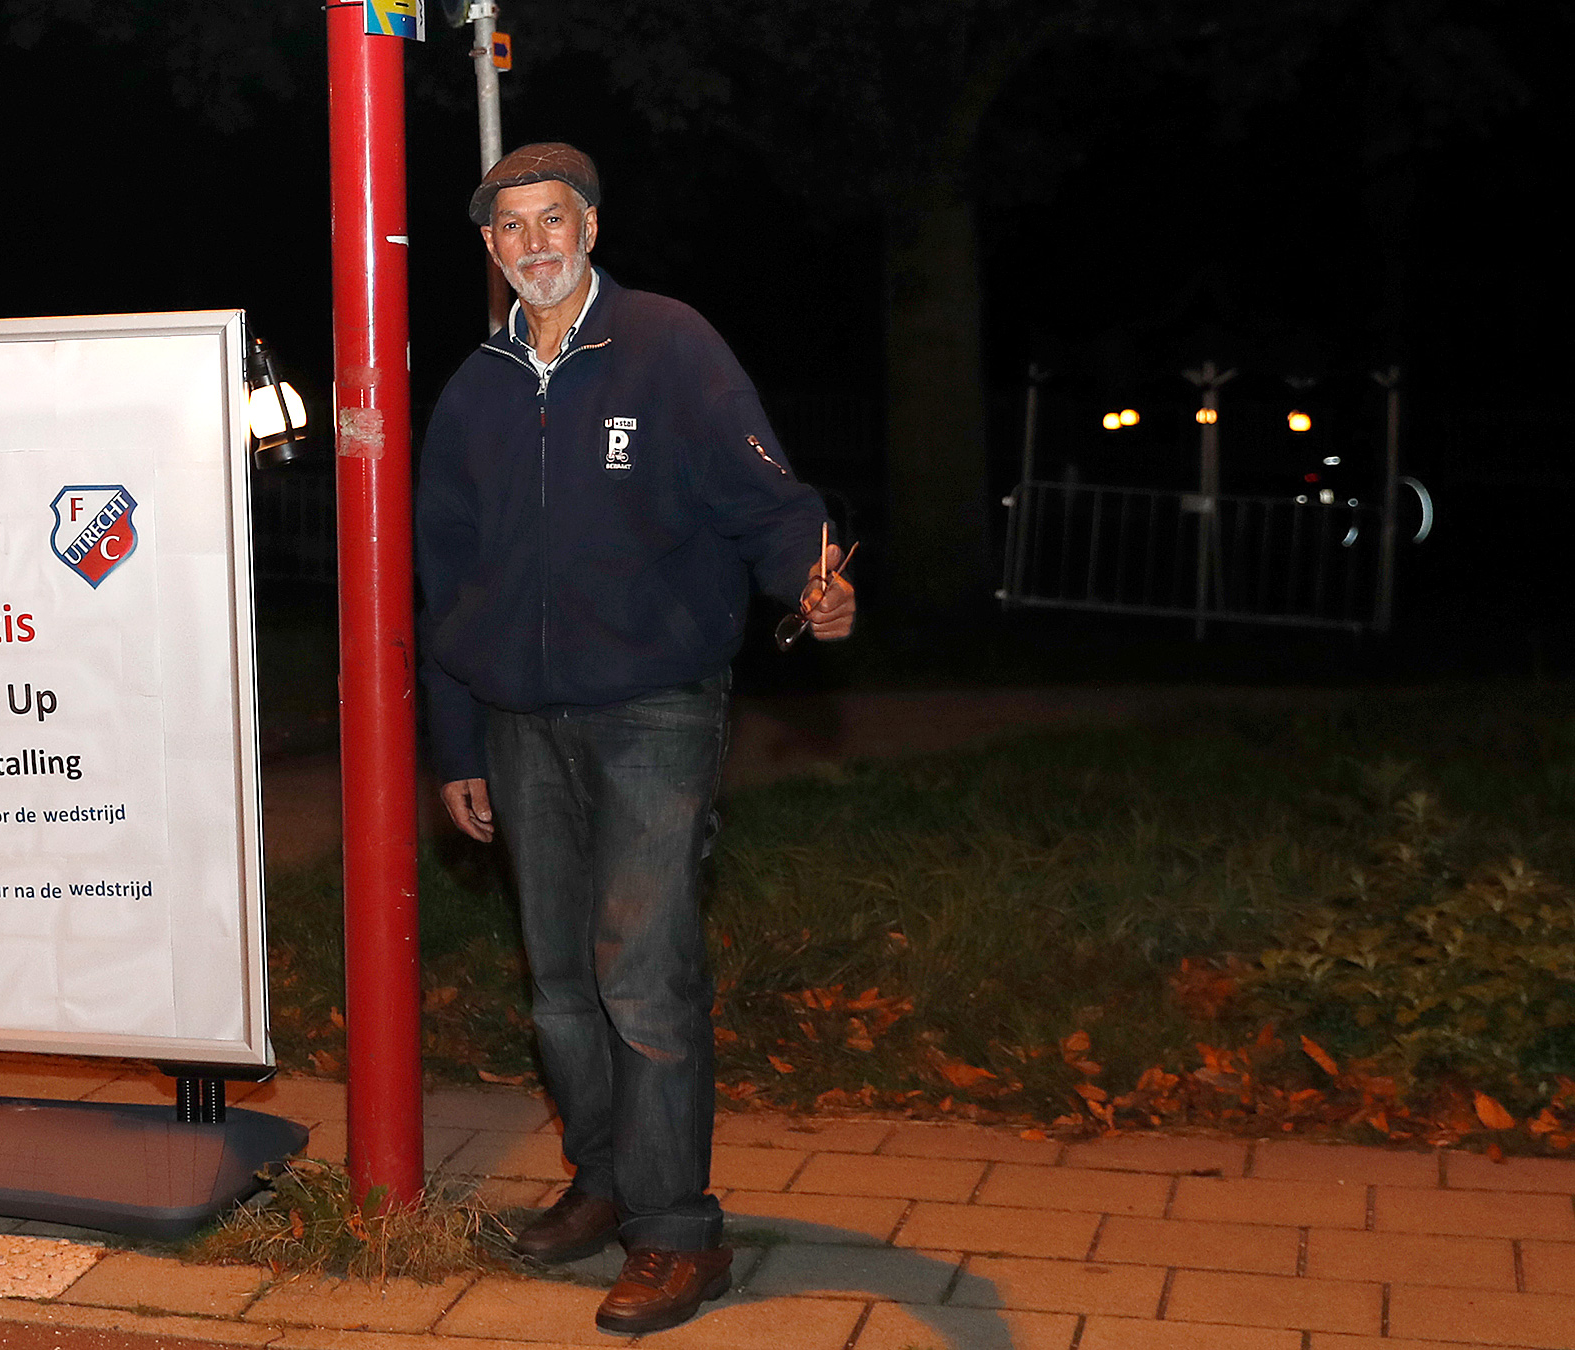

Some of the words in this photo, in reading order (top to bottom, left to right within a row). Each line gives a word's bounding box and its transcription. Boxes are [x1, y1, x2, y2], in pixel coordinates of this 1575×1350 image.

[69, 497, 84, 522] F
[64, 491, 130, 565] UTRECHT
[99, 535, 120, 561] C
[7, 683, 57, 722] Up
[15, 807, 37, 823] de
[42, 804, 126, 824] wedstrijd
[14, 886, 35, 899] na
[40, 882, 62, 899] de
[68, 881, 153, 901] wedstrijd
